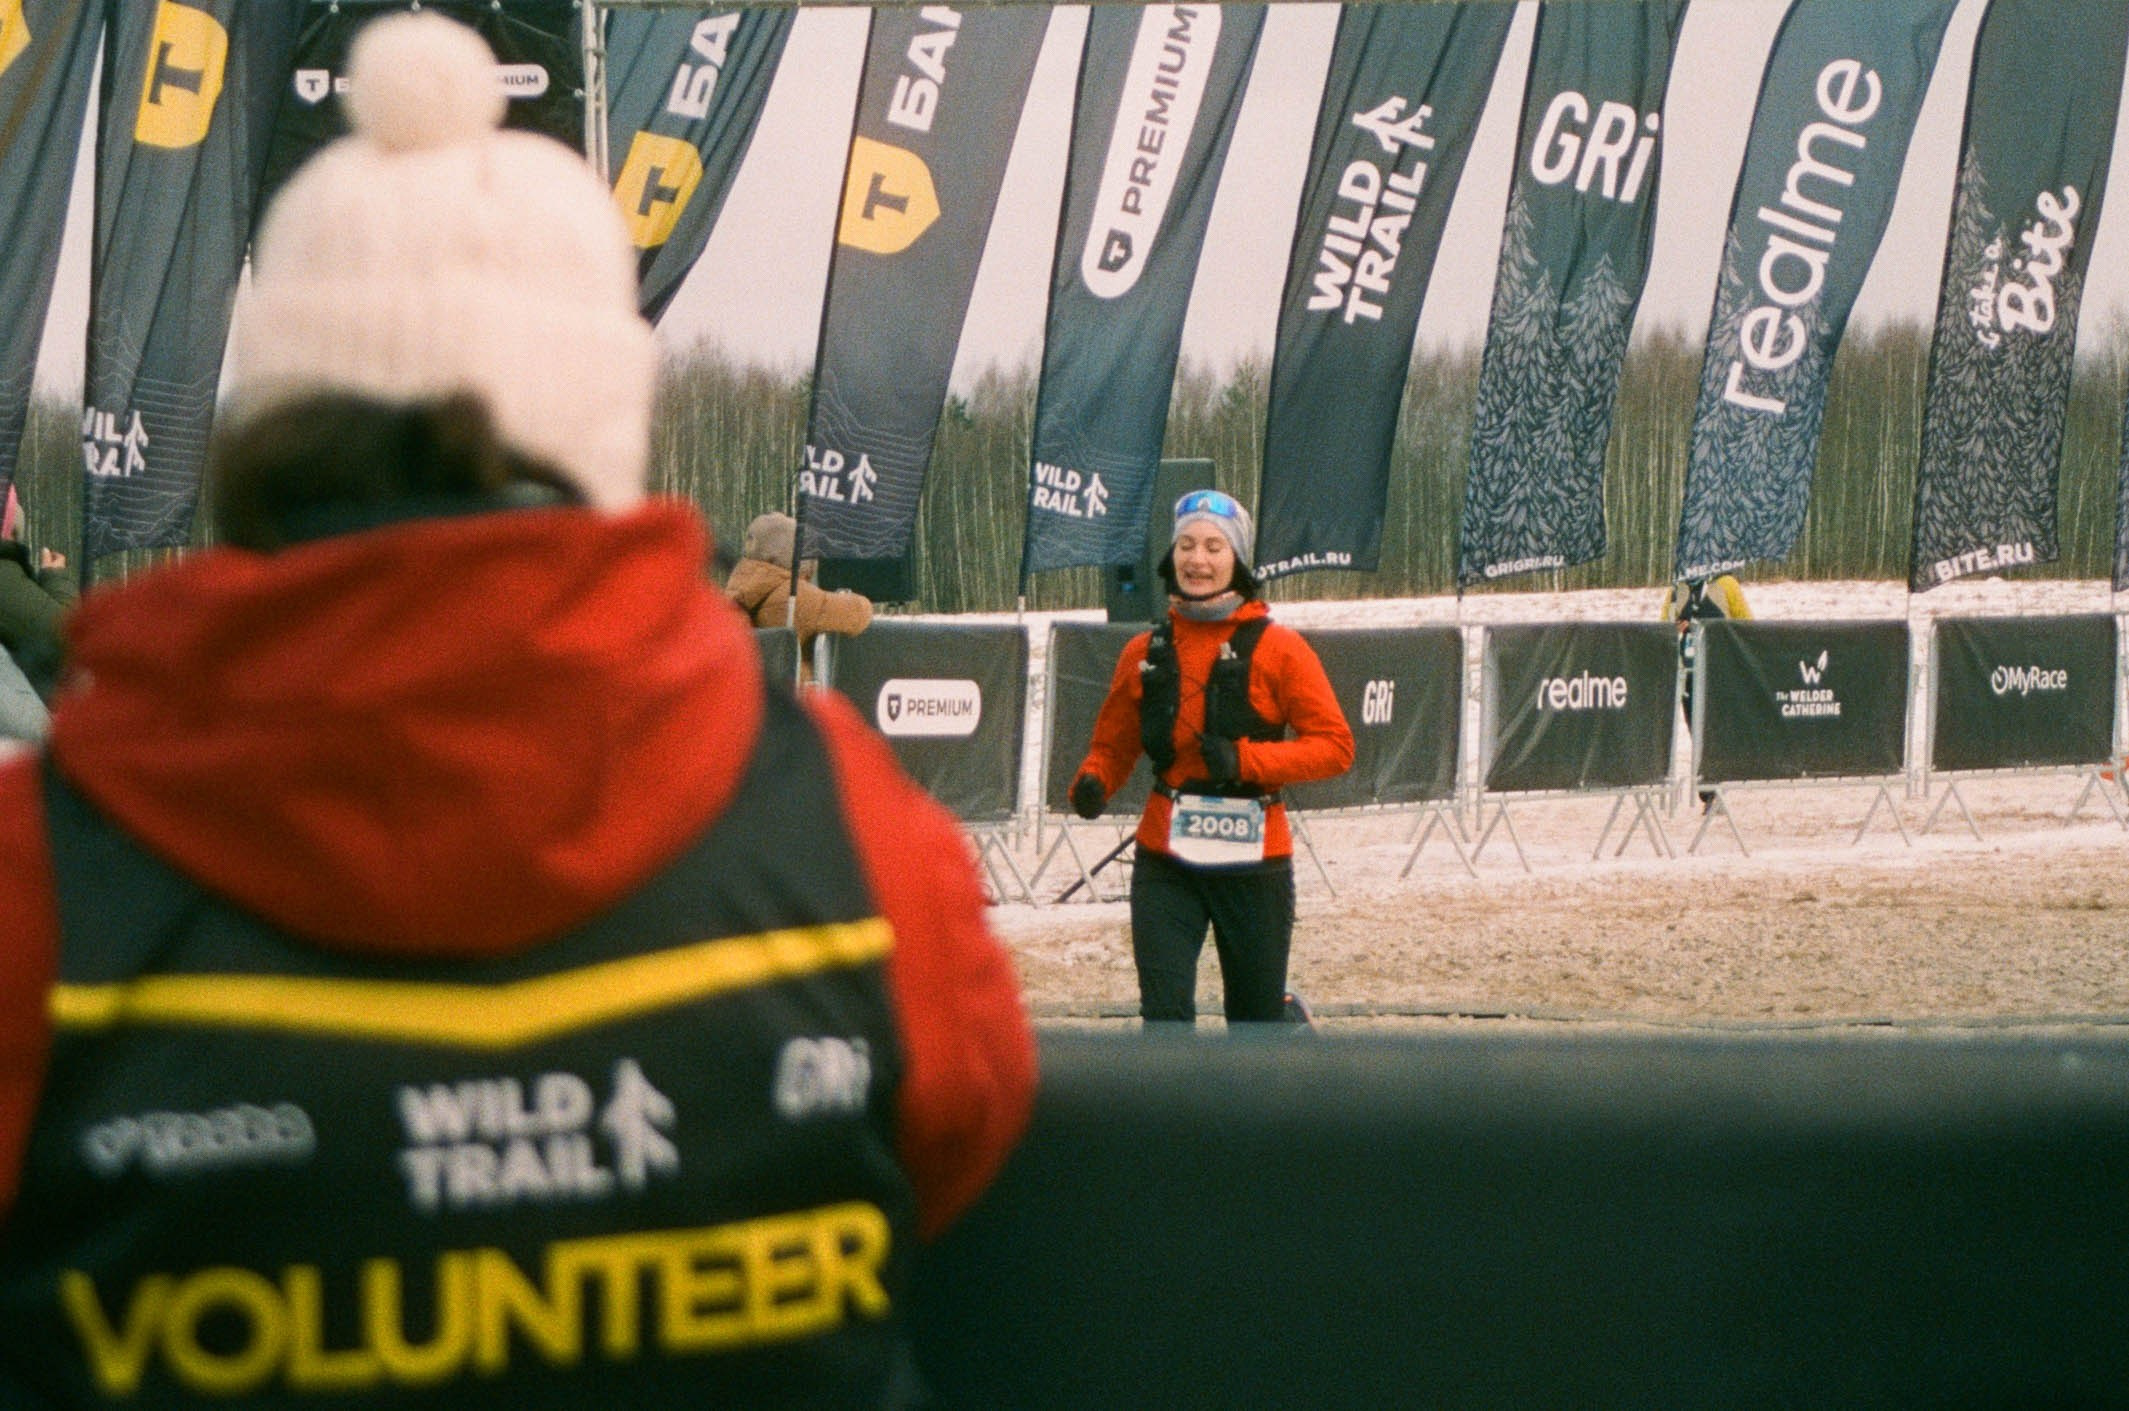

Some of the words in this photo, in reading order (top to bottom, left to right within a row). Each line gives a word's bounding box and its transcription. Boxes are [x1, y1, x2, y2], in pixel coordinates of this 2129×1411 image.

[1121, 7, 1198, 215] PREMIUM
[1531, 91, 1659, 203] GRi
[1307, 159, 1382, 312] WILD
[1344, 161, 1428, 325] TRAIL
[1723, 58, 1882, 414] realme
[1998, 185, 2080, 333] Bite
[1935, 541, 2035, 581] BITE.RU
[907, 698, 973, 716] PREMIUM
[1362, 680, 1395, 724] GRi
[1537, 669, 1627, 710] realme
[1781, 702, 1841, 717] CATHERINE
[1790, 688, 1834, 702] WELDER
[1187, 814, 1249, 837] 2008
[401, 1072, 593, 1142] WILD
[401, 1132, 614, 1210] TRAIL
[62, 1202, 892, 1394] VOLUNTEER
